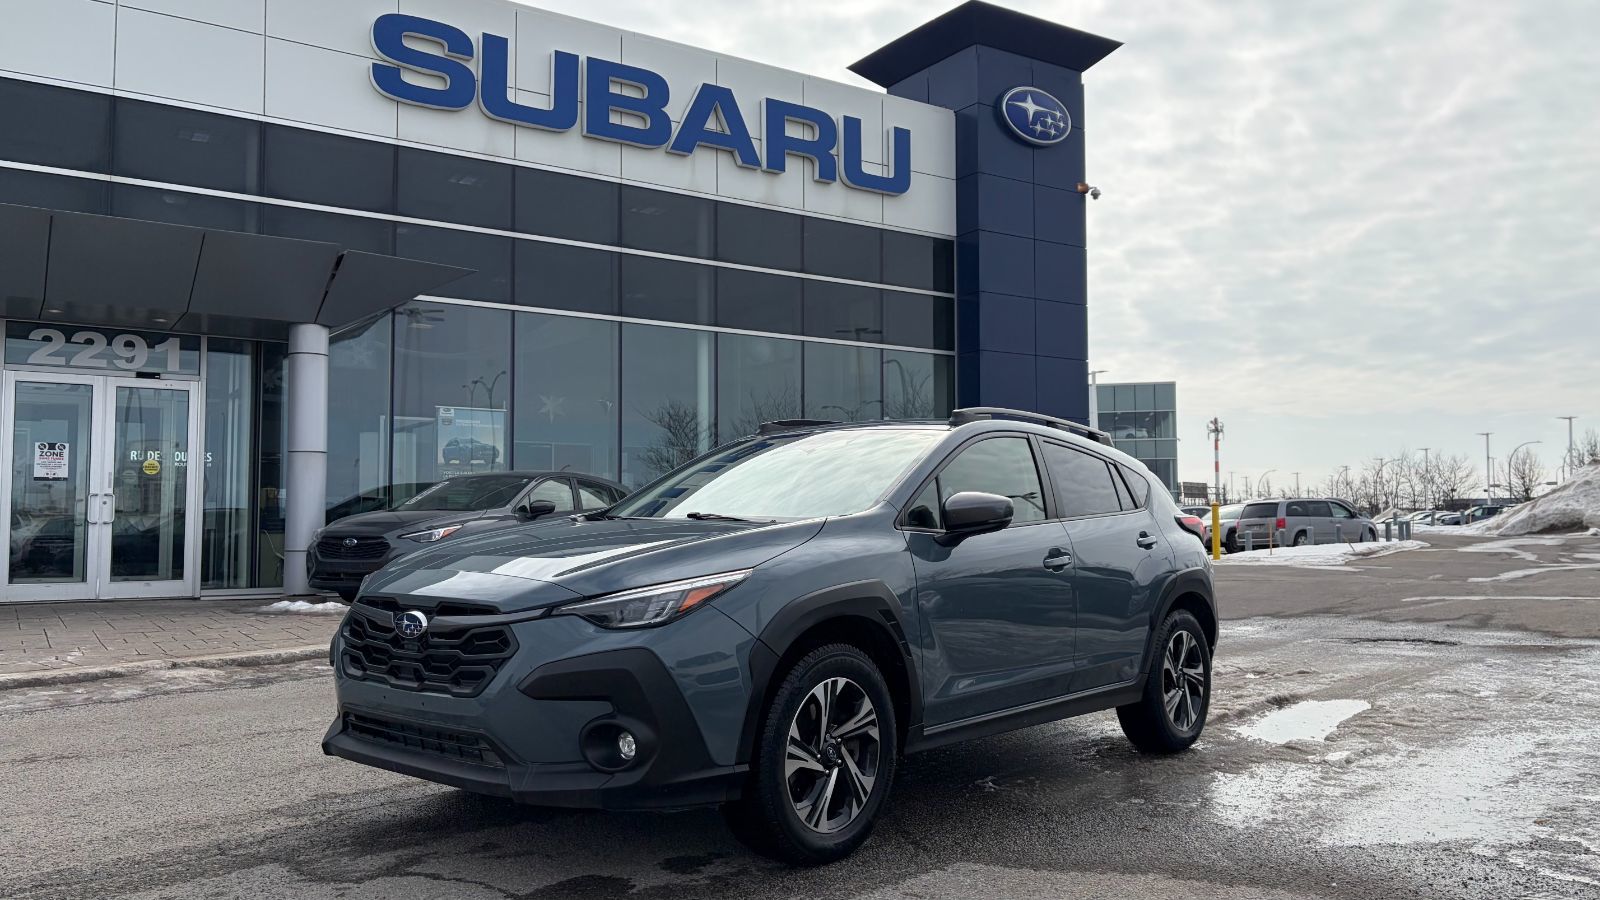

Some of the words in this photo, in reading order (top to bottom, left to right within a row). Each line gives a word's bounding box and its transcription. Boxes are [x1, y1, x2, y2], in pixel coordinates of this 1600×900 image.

[370, 13, 911, 197] SUBARU
[27, 328, 181, 371] 2291
[39, 450, 65, 458] ZONE
